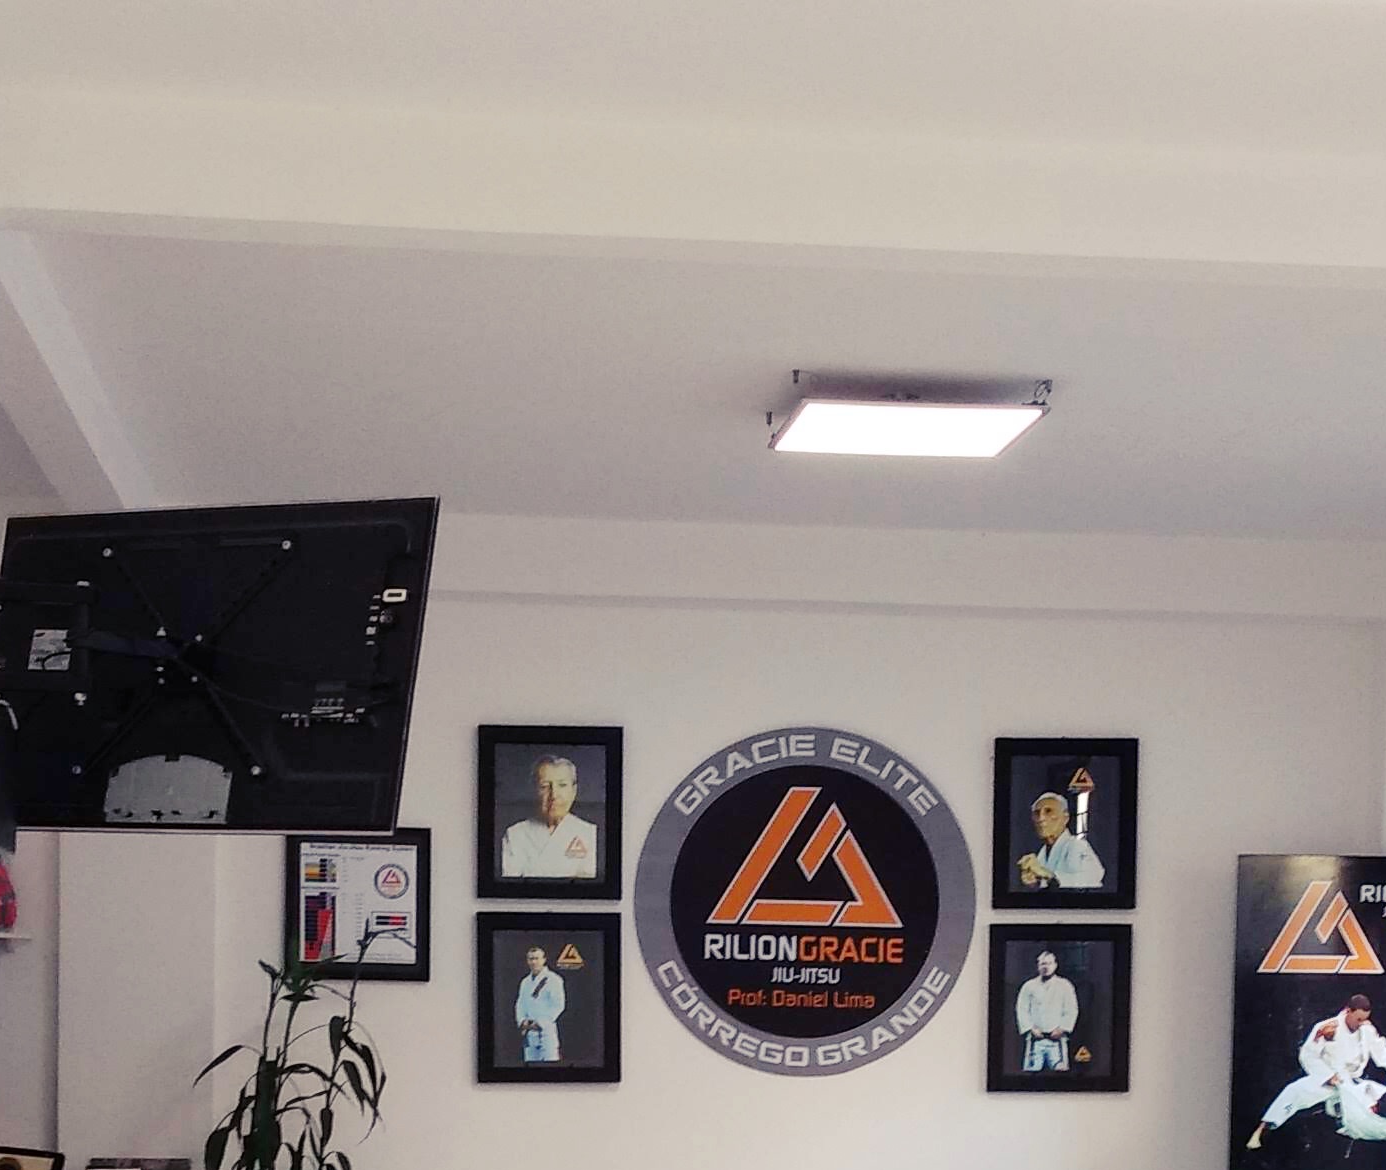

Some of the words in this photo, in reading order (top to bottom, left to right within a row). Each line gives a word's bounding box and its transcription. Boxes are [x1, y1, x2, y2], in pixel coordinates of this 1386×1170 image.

[674, 734, 816, 817] GRACIE
[830, 737, 939, 817] ELITE
[770, 967, 840, 984] JIU-JITSU
[772, 990, 827, 1008] Daniel
[834, 990, 875, 1009] Lima
[816, 966, 951, 1066] GRANDE
